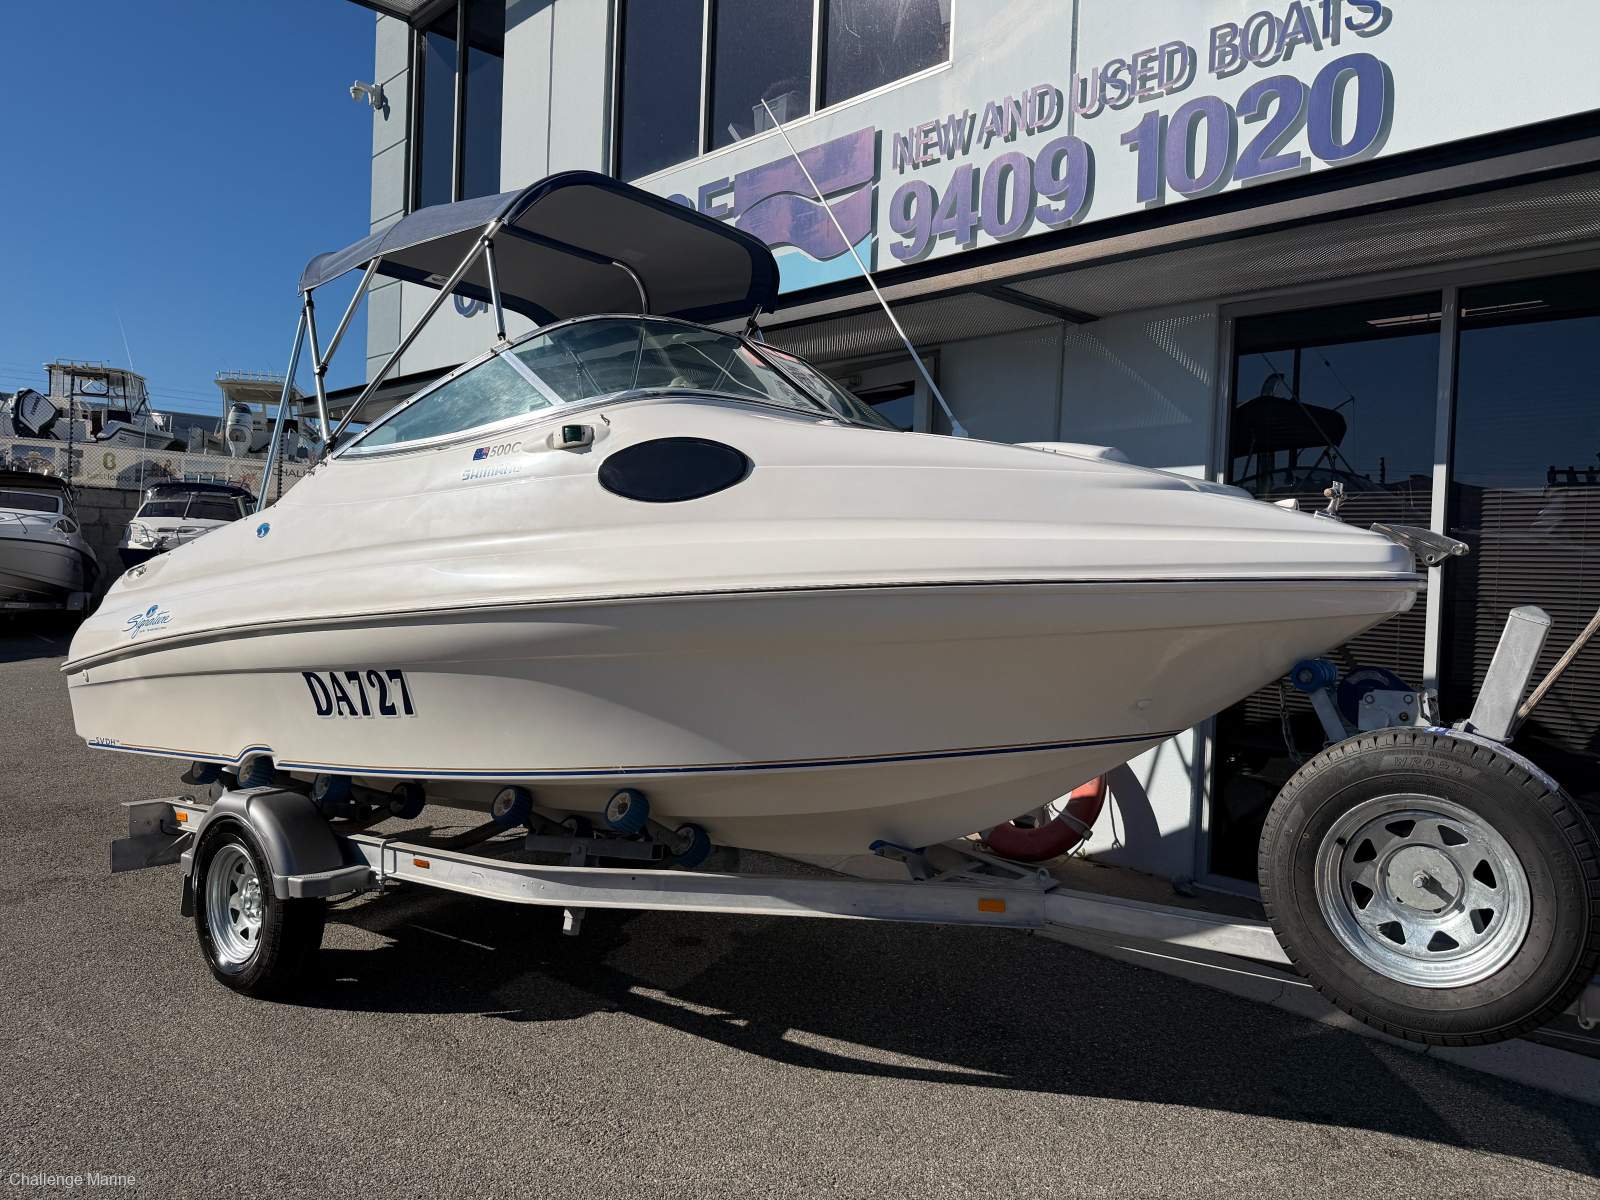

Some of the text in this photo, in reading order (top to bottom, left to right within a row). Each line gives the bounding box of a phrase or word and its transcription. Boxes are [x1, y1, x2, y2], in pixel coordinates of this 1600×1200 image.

[893, 0, 1387, 172] NEW AND USED BOATS
[889, 53, 1390, 262] 9409 1020
[489, 441, 522, 457] 500C
[121, 605, 176, 639] Signature
[302, 669, 416, 718] DA727
